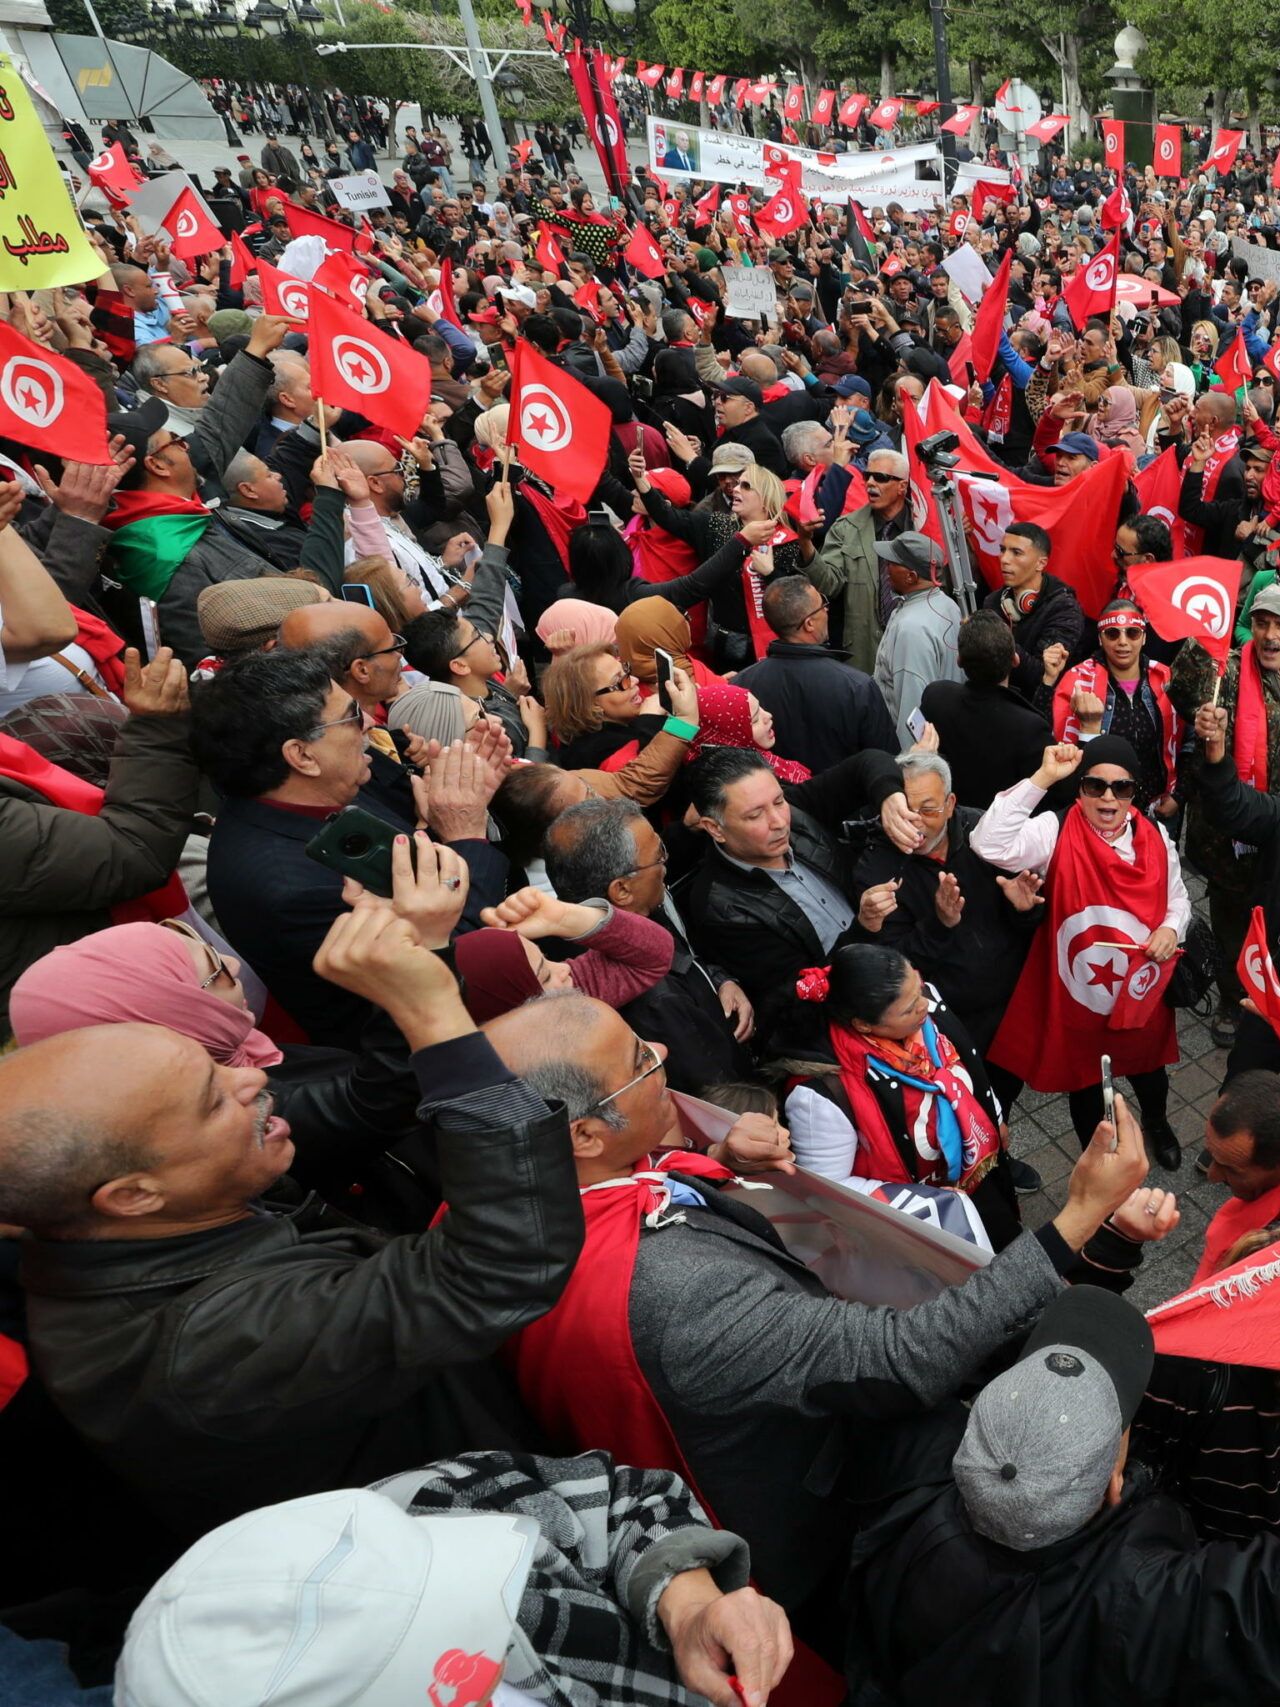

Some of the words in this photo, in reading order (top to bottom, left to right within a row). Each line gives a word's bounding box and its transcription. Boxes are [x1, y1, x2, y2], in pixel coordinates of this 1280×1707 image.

[714, 153, 731, 166] خطر
[345, 190, 378, 201] Tunisie
[3, 214, 70, 267] مطلب
[969, 1112, 990, 1145] Tunisie
